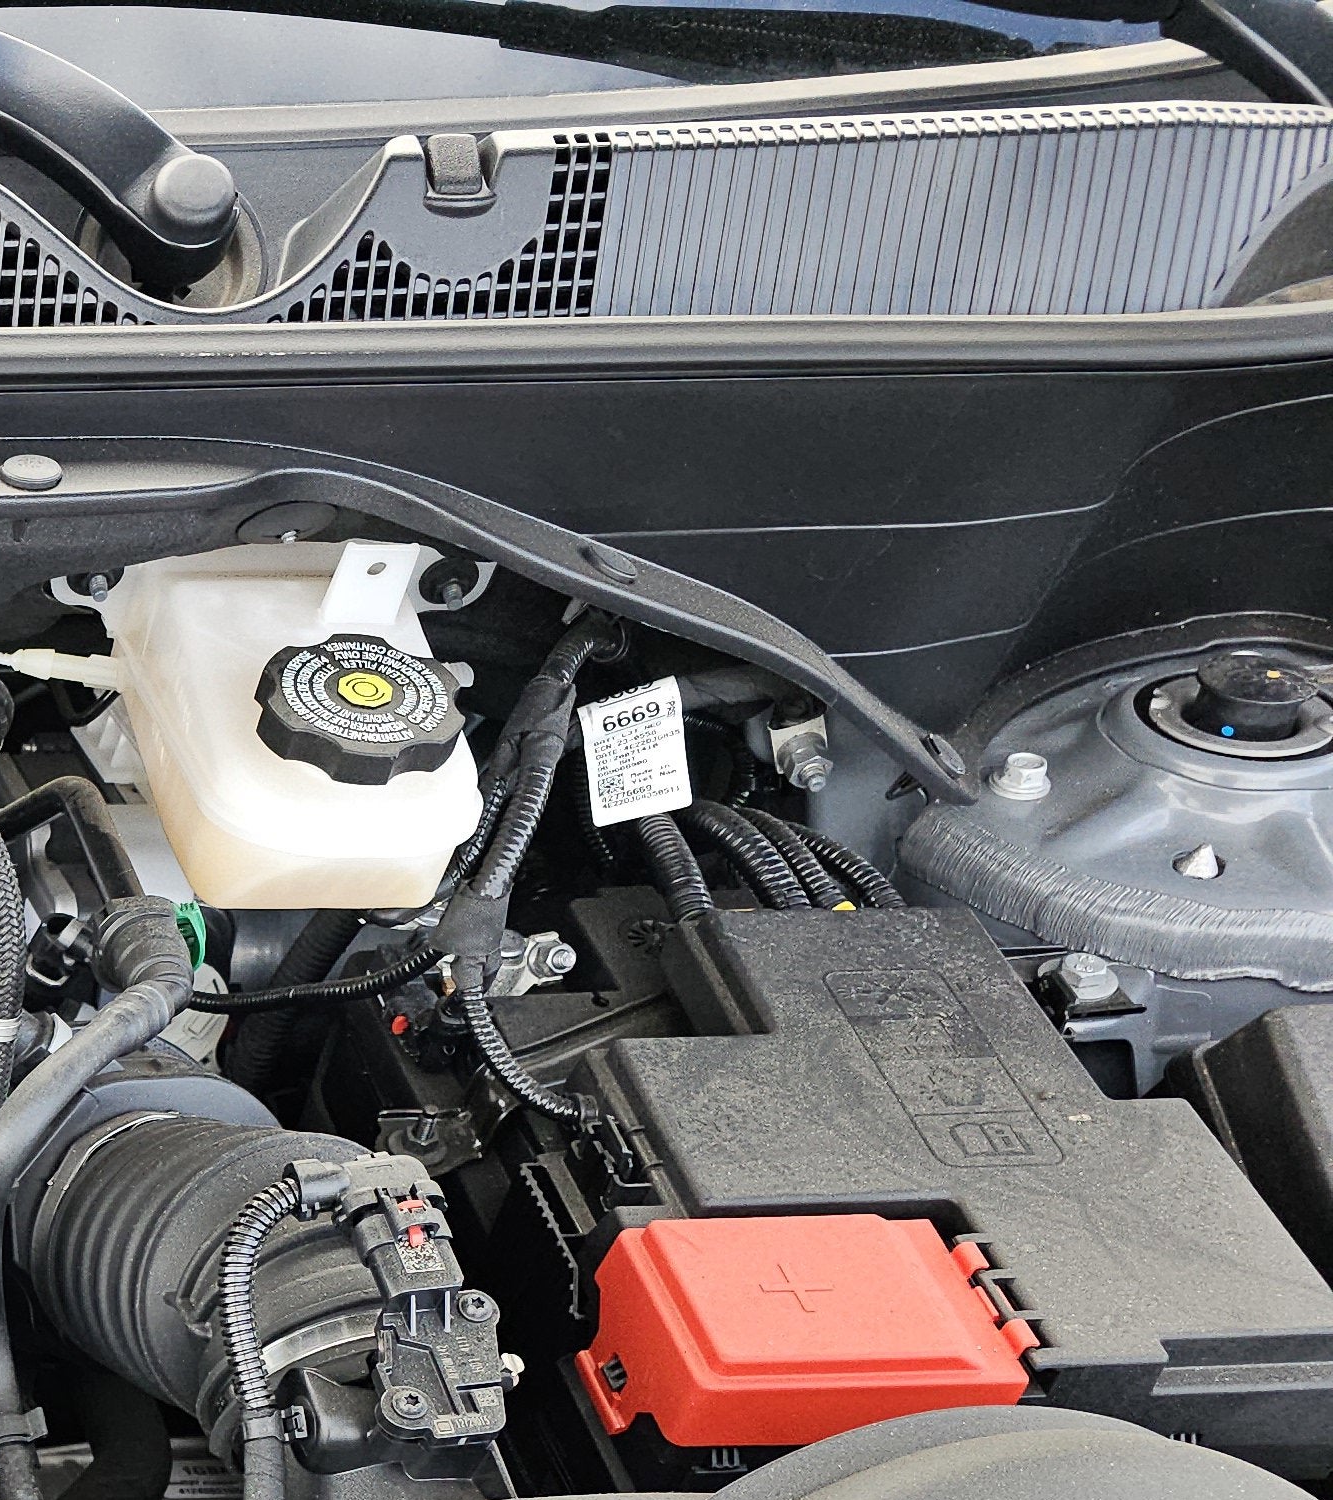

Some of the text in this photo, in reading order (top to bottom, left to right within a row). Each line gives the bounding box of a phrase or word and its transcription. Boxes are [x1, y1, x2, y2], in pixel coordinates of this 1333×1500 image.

[329, 649, 361, 661] ONLY
[338, 658, 378, 670] FILLER
[360, 650, 384, 662] USE
[384, 646, 429, 672] SEALED
[376, 662, 412, 685] CLEAN
[380, 654, 429, 685] REMOVING
[335, 706, 398, 724] PROVENANT
[602, 701, 660, 732] 6669
